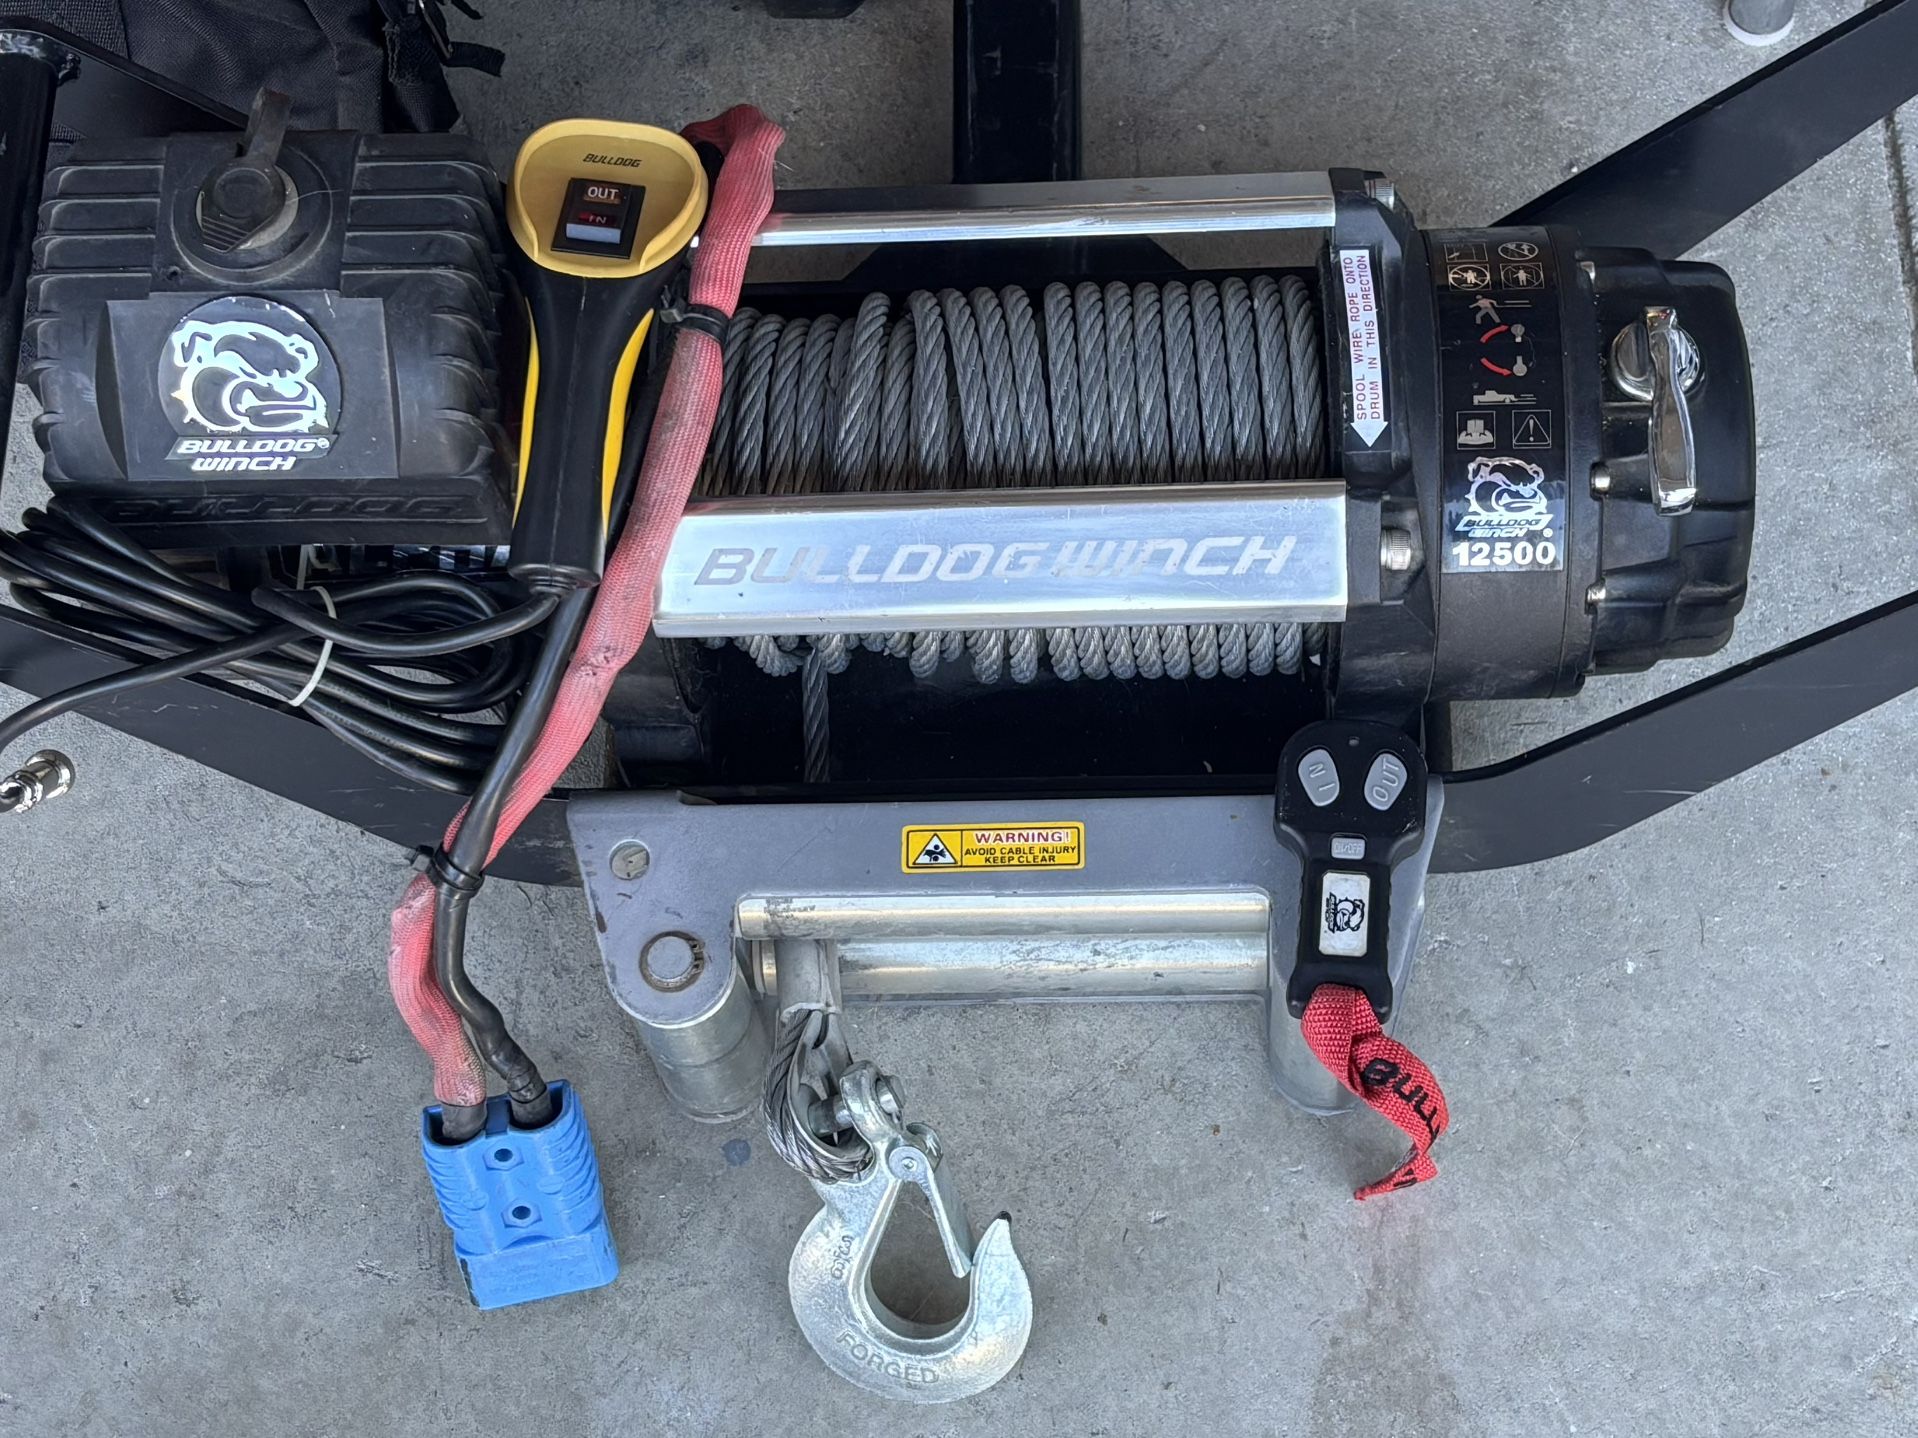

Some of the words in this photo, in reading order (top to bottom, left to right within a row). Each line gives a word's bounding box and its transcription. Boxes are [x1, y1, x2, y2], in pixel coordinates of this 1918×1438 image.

[582, 153, 643, 168] BULLDOG
[587, 186, 619, 200] OUT
[588, 215, 607, 224] IN
[1343, 257, 1356, 285] ONTO
[1357, 255, 1373, 312] DIRECTION
[1348, 292, 1360, 322] ROPE
[1365, 320, 1376, 347] THIS
[1352, 331, 1364, 364] WIRE
[1368, 357, 1378, 369] IN
[1355, 374, 1367, 420] SPOOL
[1370, 381, 1381, 420] DRUM
[177, 438, 319, 454] BULLDOG
[191, 456, 297, 472] WINCH
[1463, 519, 1543, 528] BULLDOG
[1452, 541, 1556, 567] 12500
[1308, 763, 1335, 791] IN
[1373, 758, 1399, 802] OUT
[964, 847, 996, 856] AVOID
[1000, 847, 1035, 856] CABLE
[1039, 846, 1077, 855] INJURY
[975, 832, 1069, 844] WARNING!
[984, 855, 1015, 864] KEEP
[1018, 855, 1056, 864] CLEAR
[836, 1329, 939, 1384] FORGED
